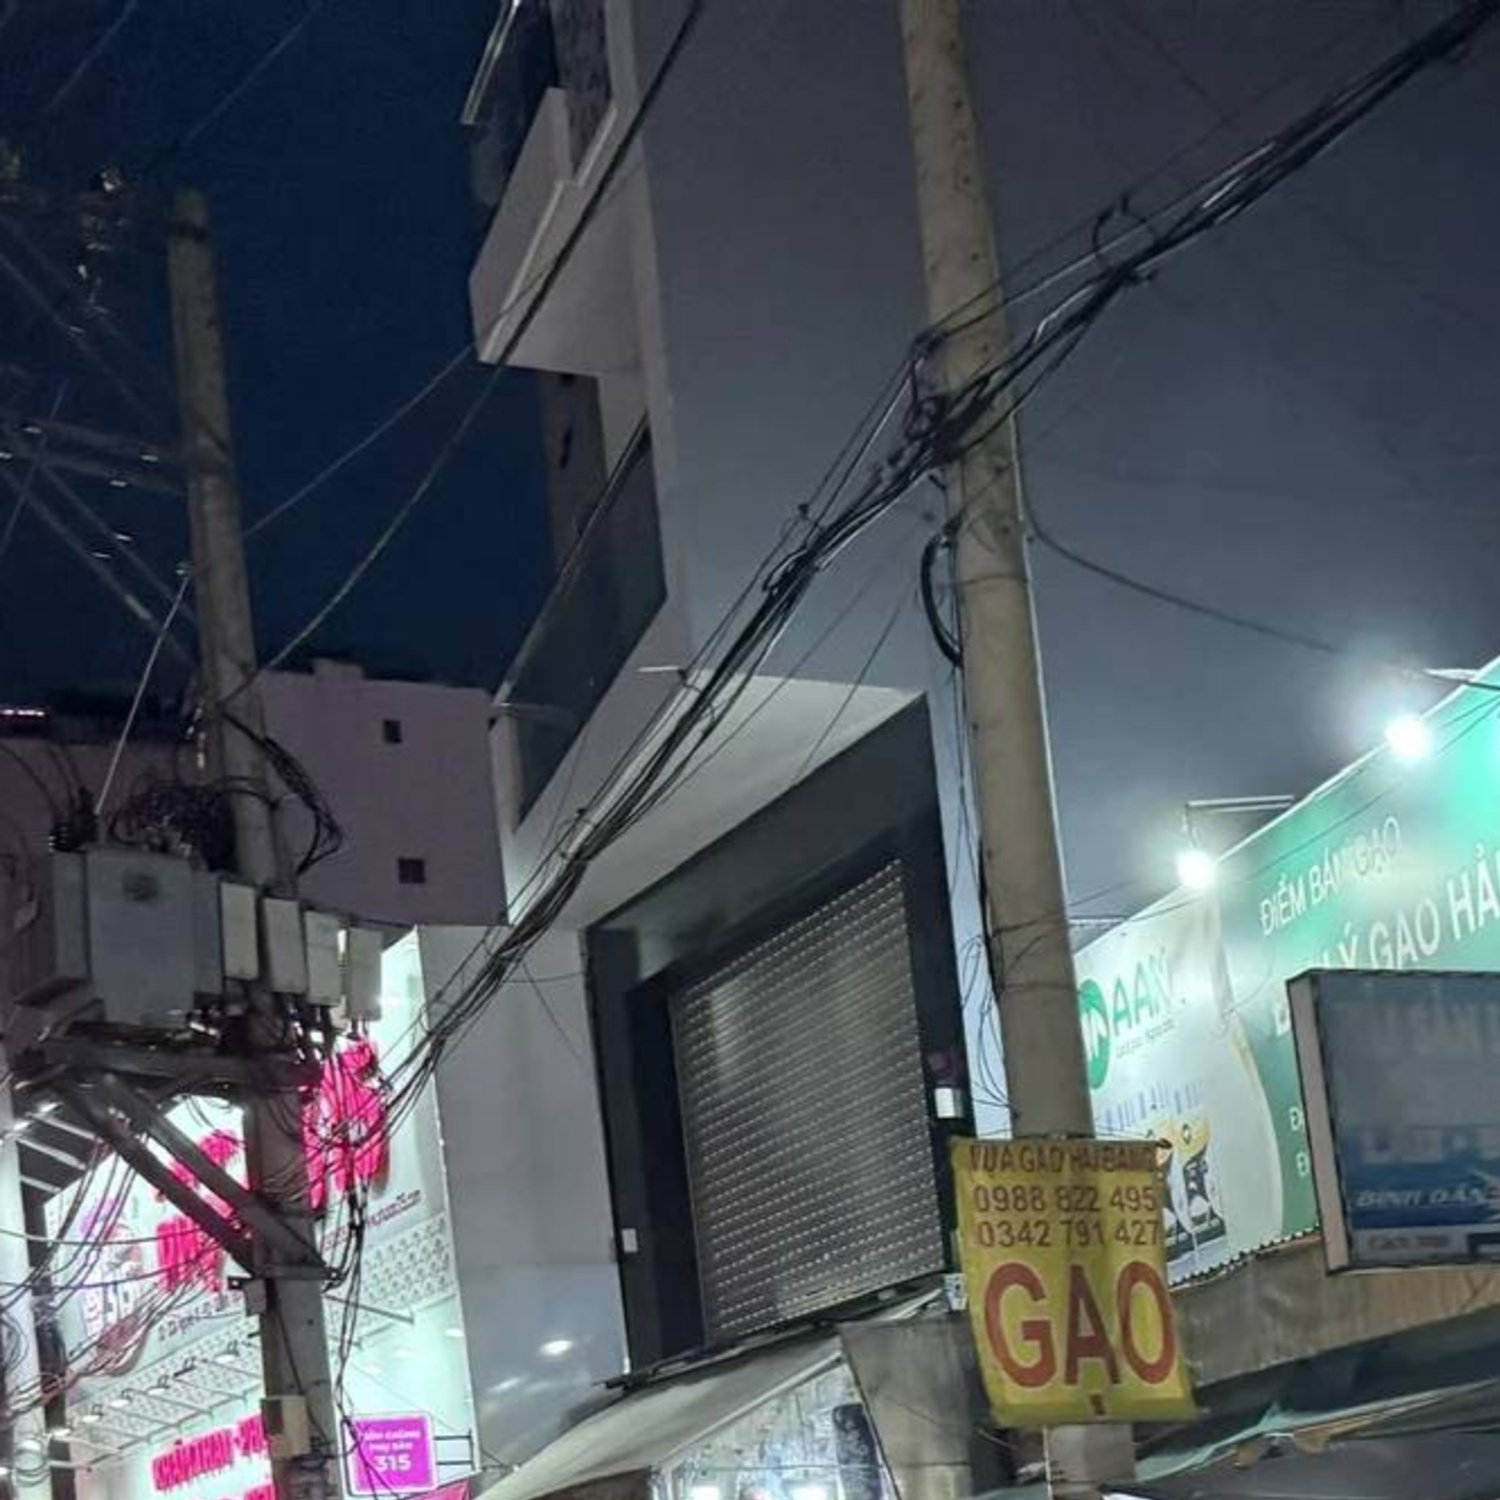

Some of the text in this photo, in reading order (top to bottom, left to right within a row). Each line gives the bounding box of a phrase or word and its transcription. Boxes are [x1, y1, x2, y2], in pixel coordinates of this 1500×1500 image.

[1110, 1185, 1156, 1212] 495
[978, 1219, 1050, 1248] 0342
[1114, 1219, 1159, 1246] 427
